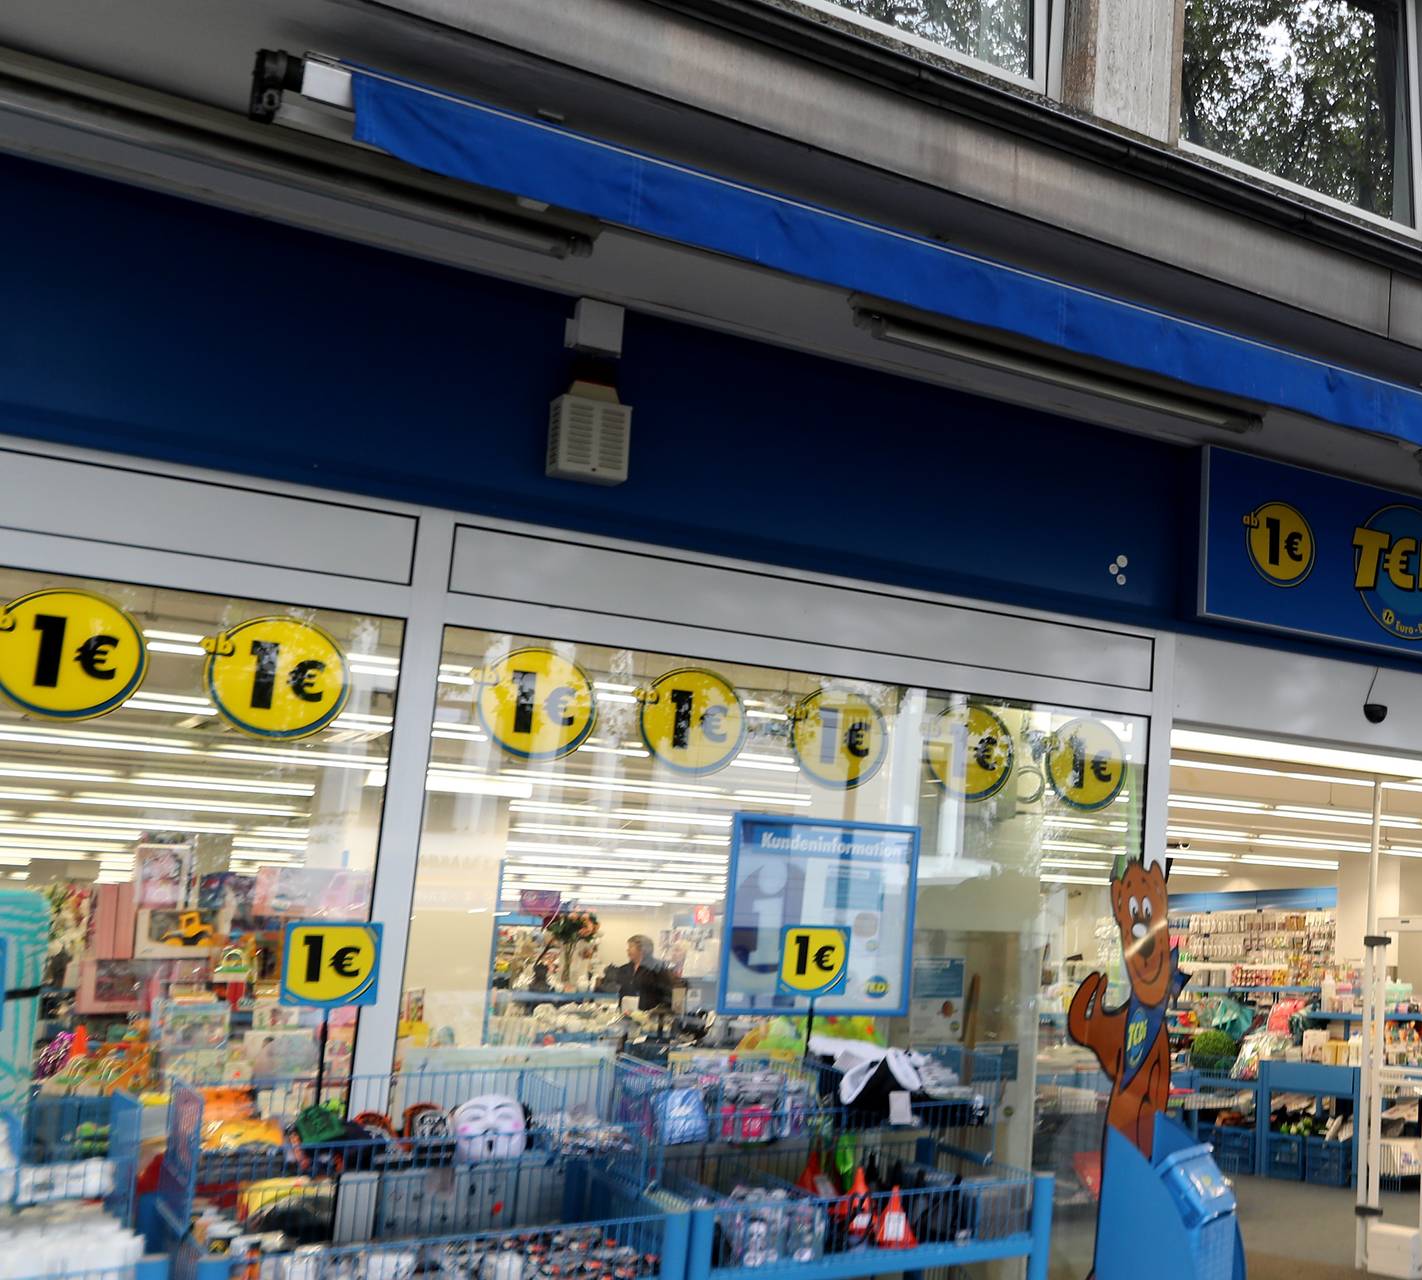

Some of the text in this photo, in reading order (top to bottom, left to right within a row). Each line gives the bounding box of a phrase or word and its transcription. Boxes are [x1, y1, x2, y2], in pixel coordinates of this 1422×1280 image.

[1242, 511, 1303, 566] ab 1€
[33, 613, 120, 689] 1€
[202, 632, 326, 710] ab 1€
[512, 670, 575, 734] 1€
[671, 689, 728, 749] 1€
[819, 707, 871, 765] 1€
[951, 721, 998, 778] 1€
[761, 831, 903, 859] Kundeninformation
[302, 934, 361, 984] 1€
[793, 935, 836, 976] 1€
